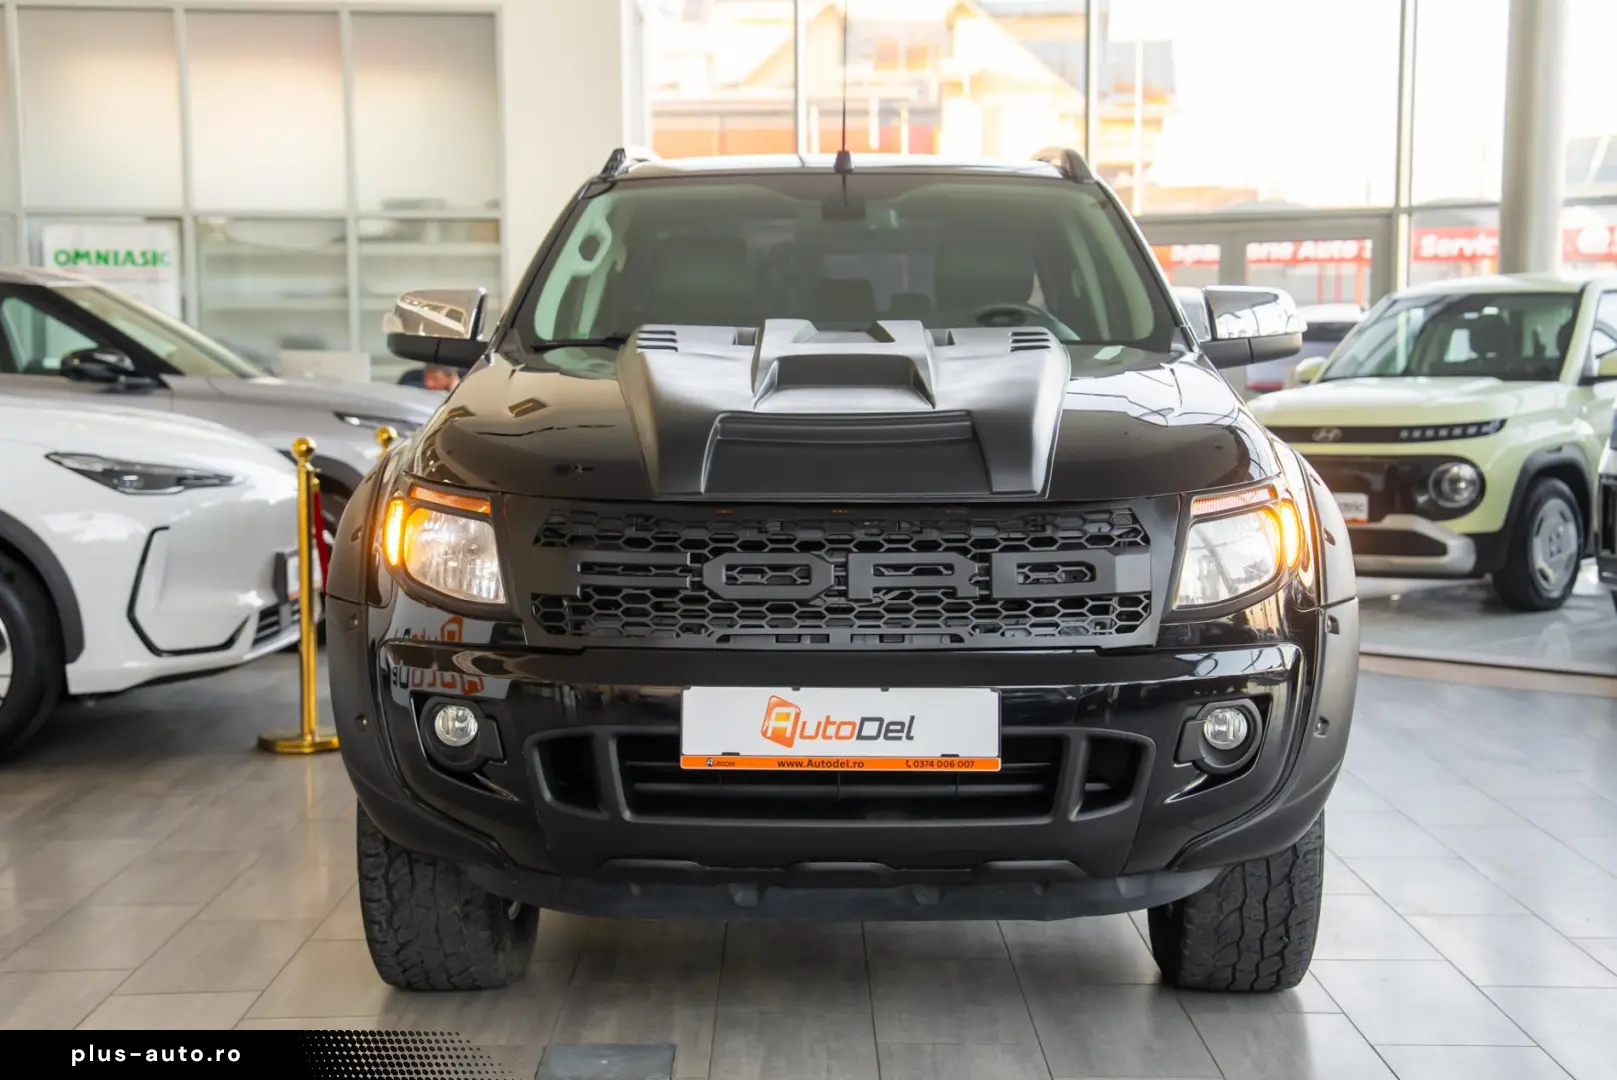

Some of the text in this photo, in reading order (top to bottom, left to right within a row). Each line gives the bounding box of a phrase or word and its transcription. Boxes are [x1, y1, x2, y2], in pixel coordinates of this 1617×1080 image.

[546, 550, 1120, 600] FORD
[763, 703, 915, 742] AutoDel
[777, 758, 865, 769] www.Autodel.ro
[913, 759, 975, 769] 0374 006 007
